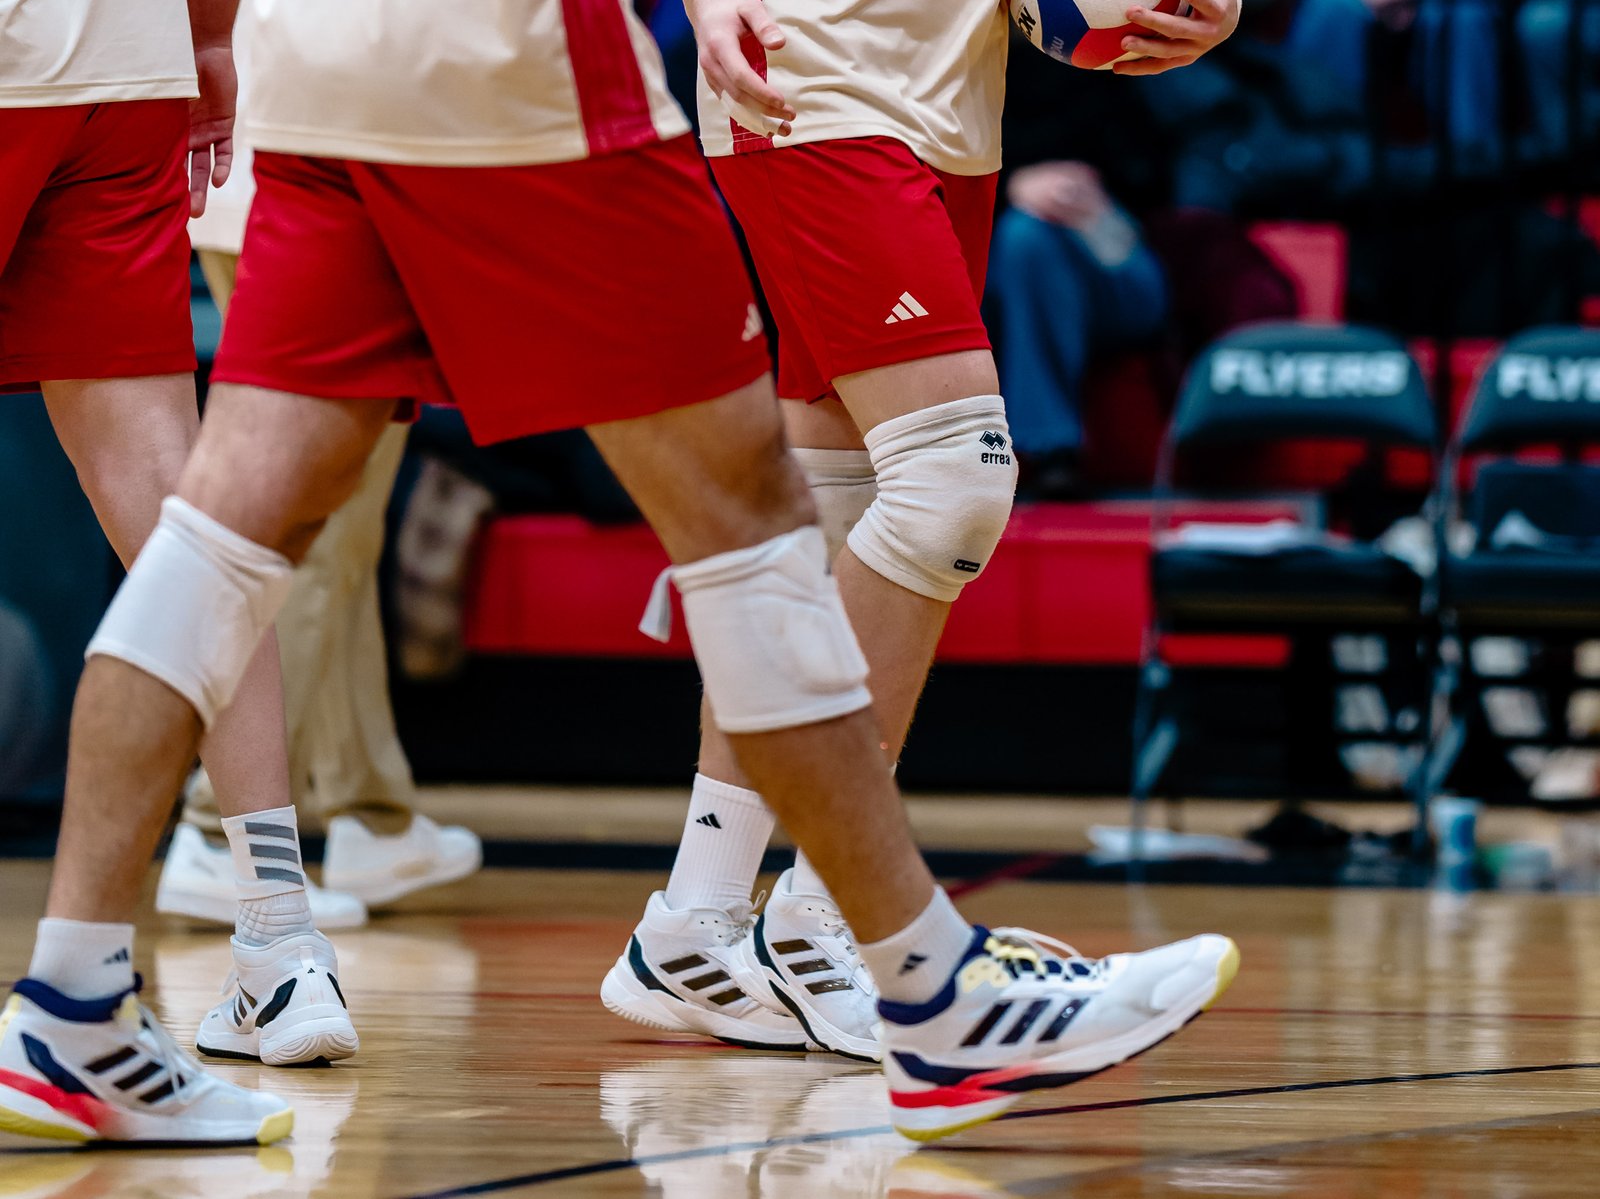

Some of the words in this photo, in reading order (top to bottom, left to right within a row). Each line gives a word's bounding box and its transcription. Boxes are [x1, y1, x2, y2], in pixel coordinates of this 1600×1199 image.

[1210, 349, 1409, 398] FLYERS
[1497, 353, 1600, 402] FLY
[981, 452, 1010, 465] errea
